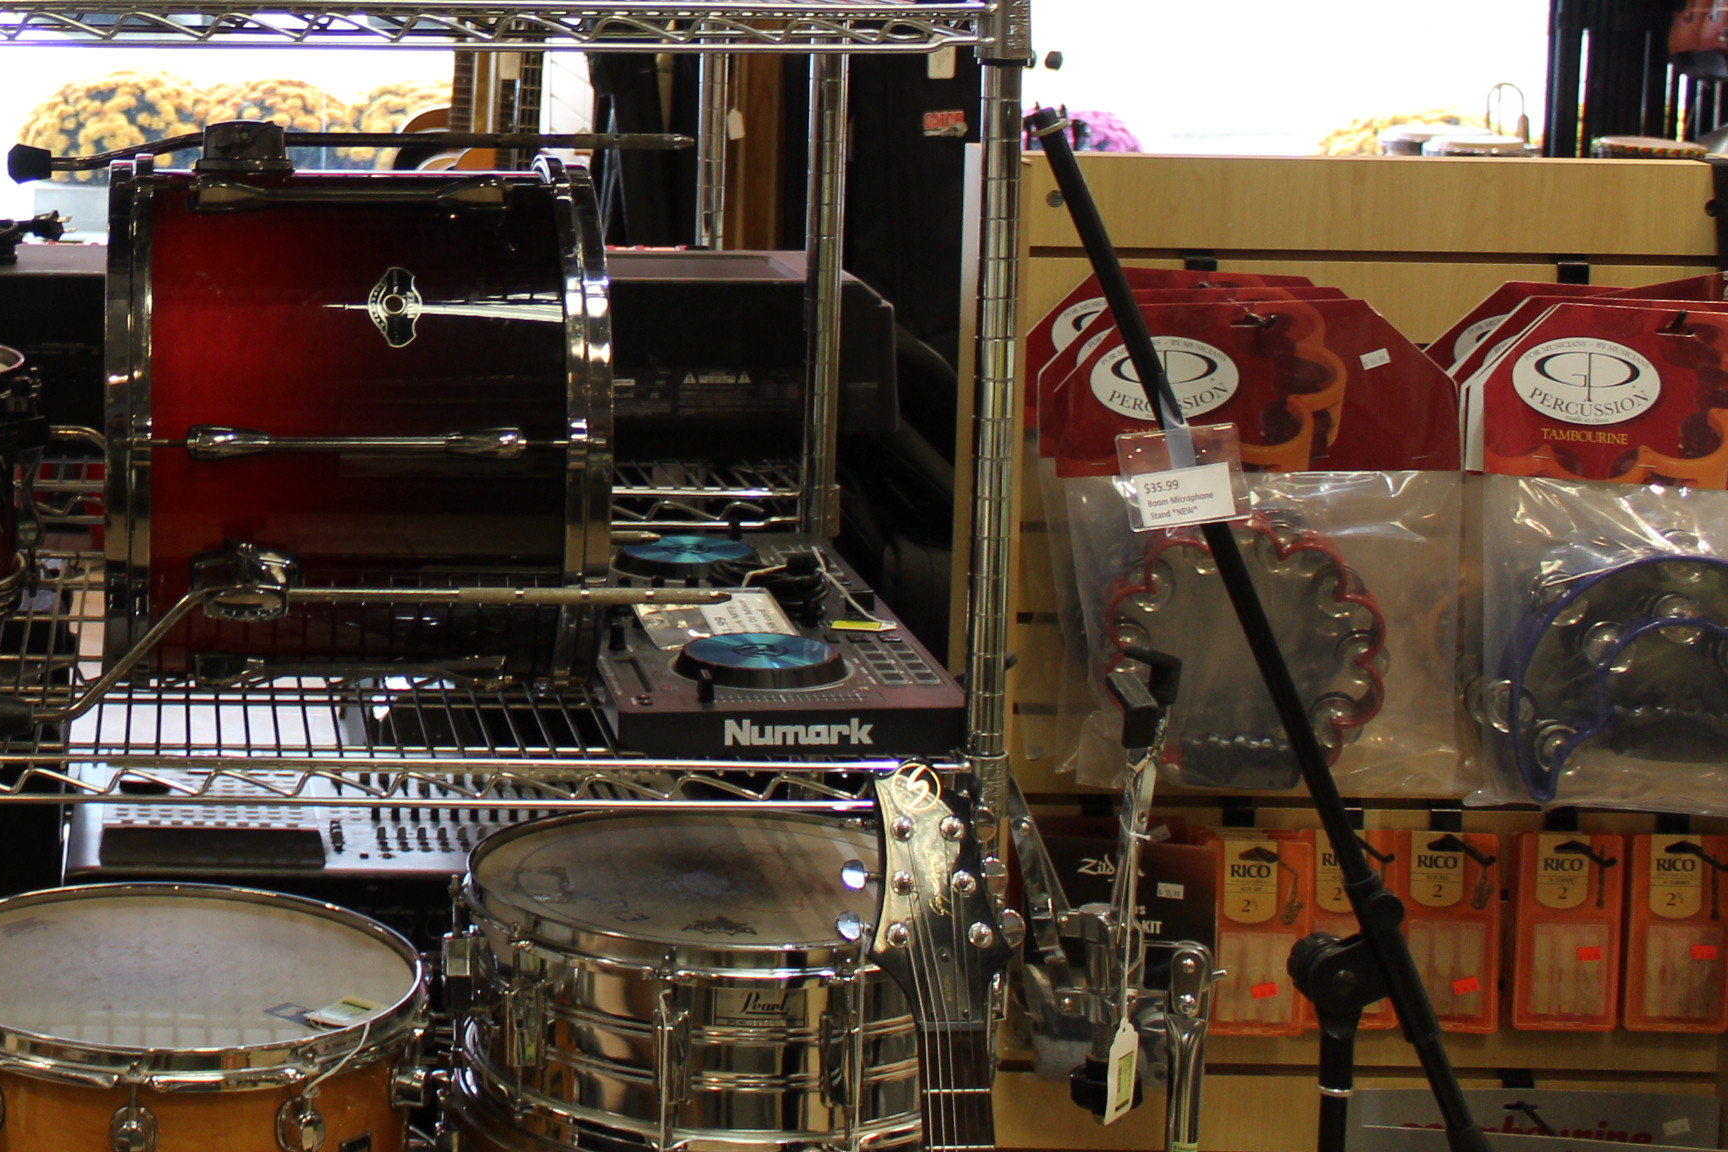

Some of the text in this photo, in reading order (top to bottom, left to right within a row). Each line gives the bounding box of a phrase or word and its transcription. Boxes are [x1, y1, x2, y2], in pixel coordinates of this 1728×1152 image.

[1108, 382, 1229, 413] PERCSSION
[1528, 387, 1650, 417] PERCUSSION
[1540, 428, 1629, 445] TAMBOURINE
[1144, 479, 1179, 494] $35.99
[1147, 492, 1214, 507] Boom Microphone
[1150, 510, 1171, 520] Stand
[724, 717, 873, 746] Numark
[1417, 855, 1458, 869] RICO
[1543, 857, 1583, 872] RICO
[1656, 858, 1696, 872] RICO
[1230, 864, 1271, 878] RICO
[1433, 884, 1443, 898] 2
[1558, 887, 1568, 899] 2
[740, 991, 789, 1012] Pearl
